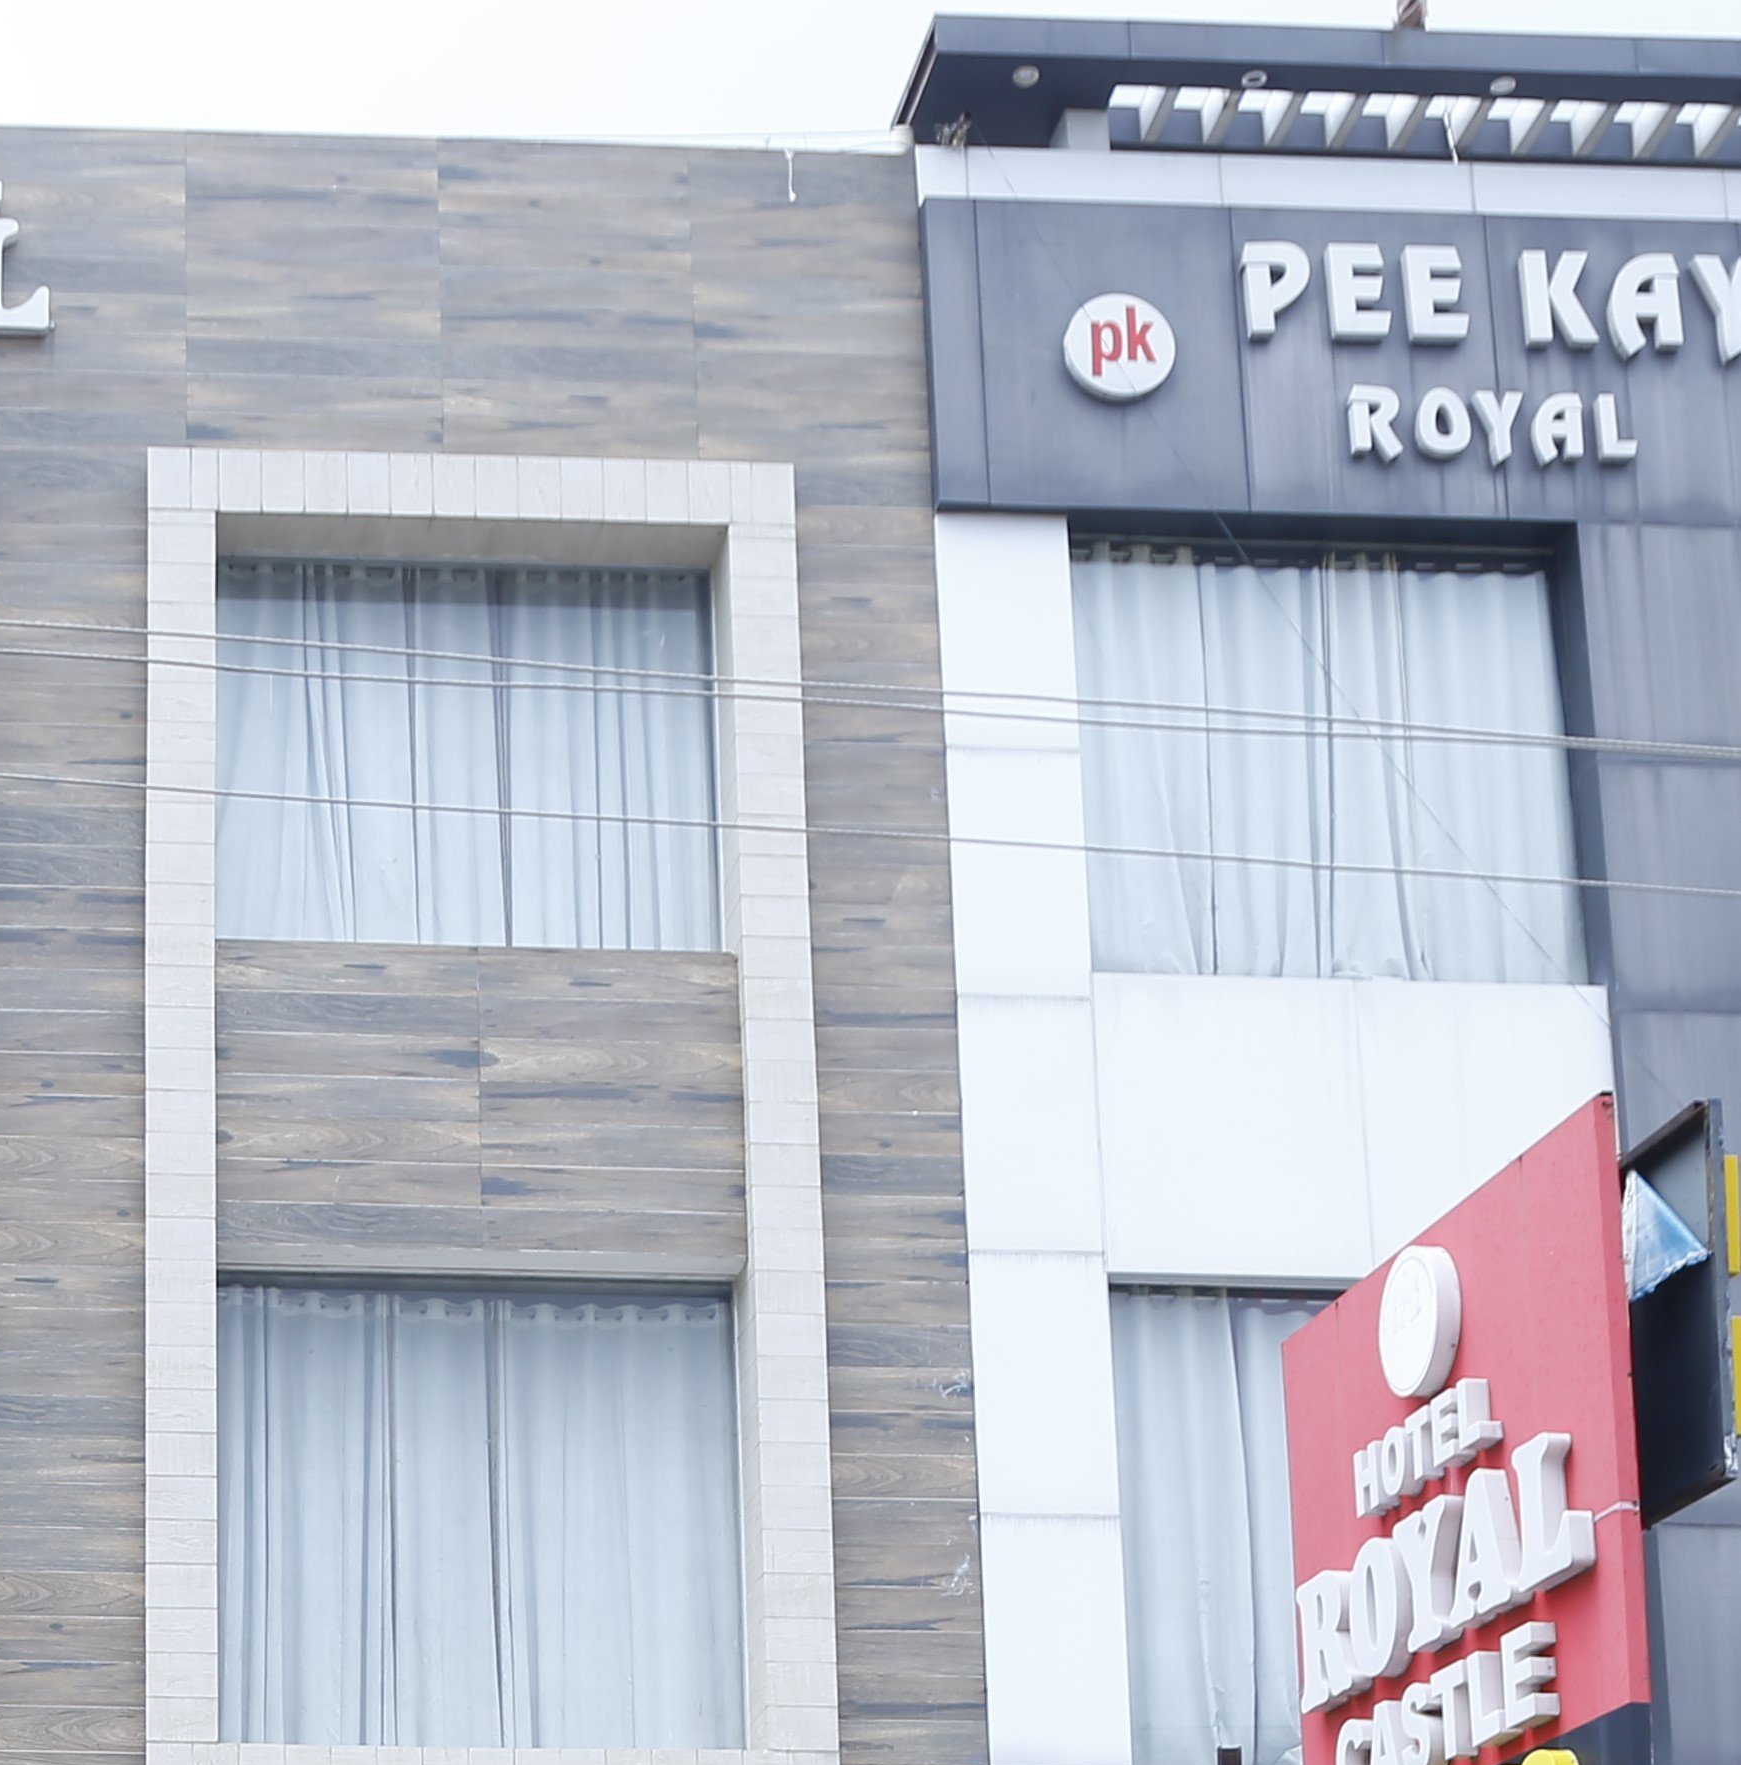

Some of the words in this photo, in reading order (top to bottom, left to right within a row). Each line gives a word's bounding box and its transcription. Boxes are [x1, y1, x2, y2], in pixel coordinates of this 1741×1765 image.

[1090, 305, 1158, 377] pk
[1240, 240, 1470, 344] PEE
[1346, 384, 1638, 467] ROYAL
[1354, 1377, 1504, 1518] HOTEL
[1296, 1432, 1596, 1714] ROYAL
